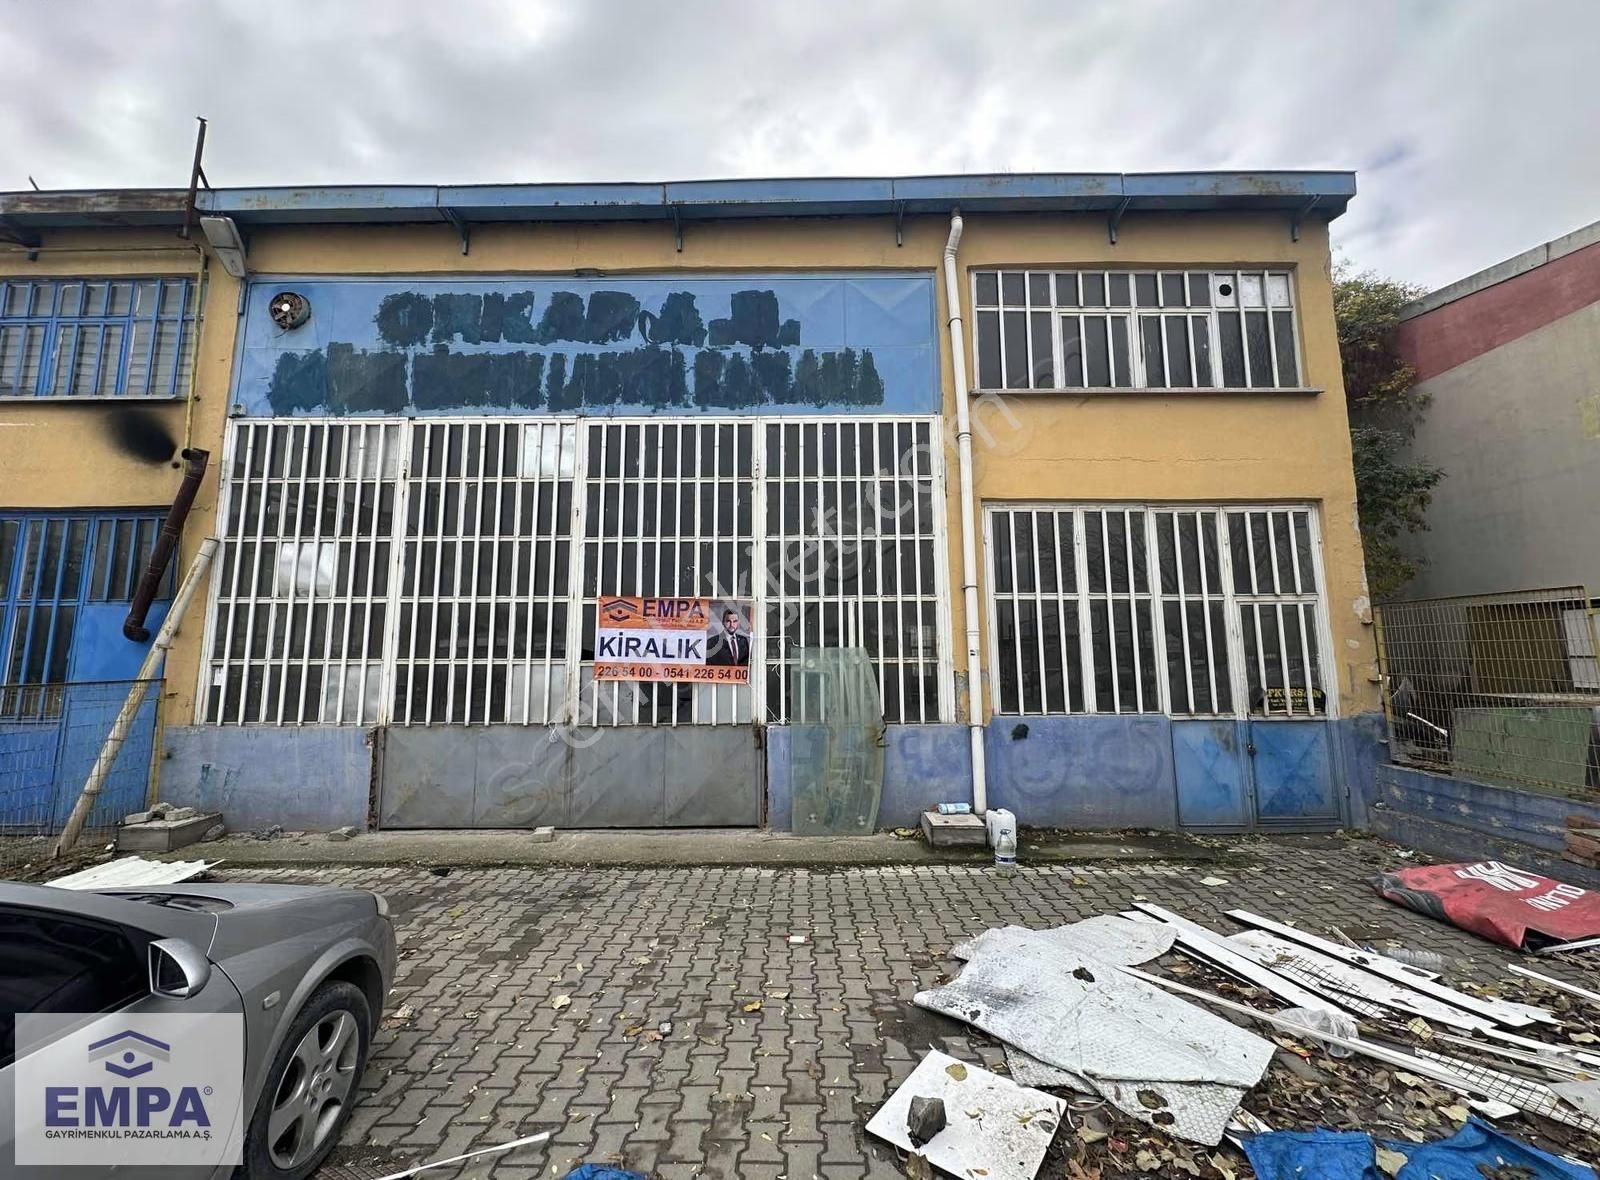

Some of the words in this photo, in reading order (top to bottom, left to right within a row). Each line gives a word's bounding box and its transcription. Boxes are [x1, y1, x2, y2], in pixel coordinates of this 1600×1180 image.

[643, 599, 704, 618] EMPA
[598, 632, 702, 659] KİRALIK
[598, 666, 618, 677] 226
[623, 666, 636, 677] 54
[639, 667, 652, 678] 00
[664, 667, 689, 679] 0541
[694, 668, 714, 679] 226
[718, 669, 731, 680] 54
[735, 669, 748, 680] 00
